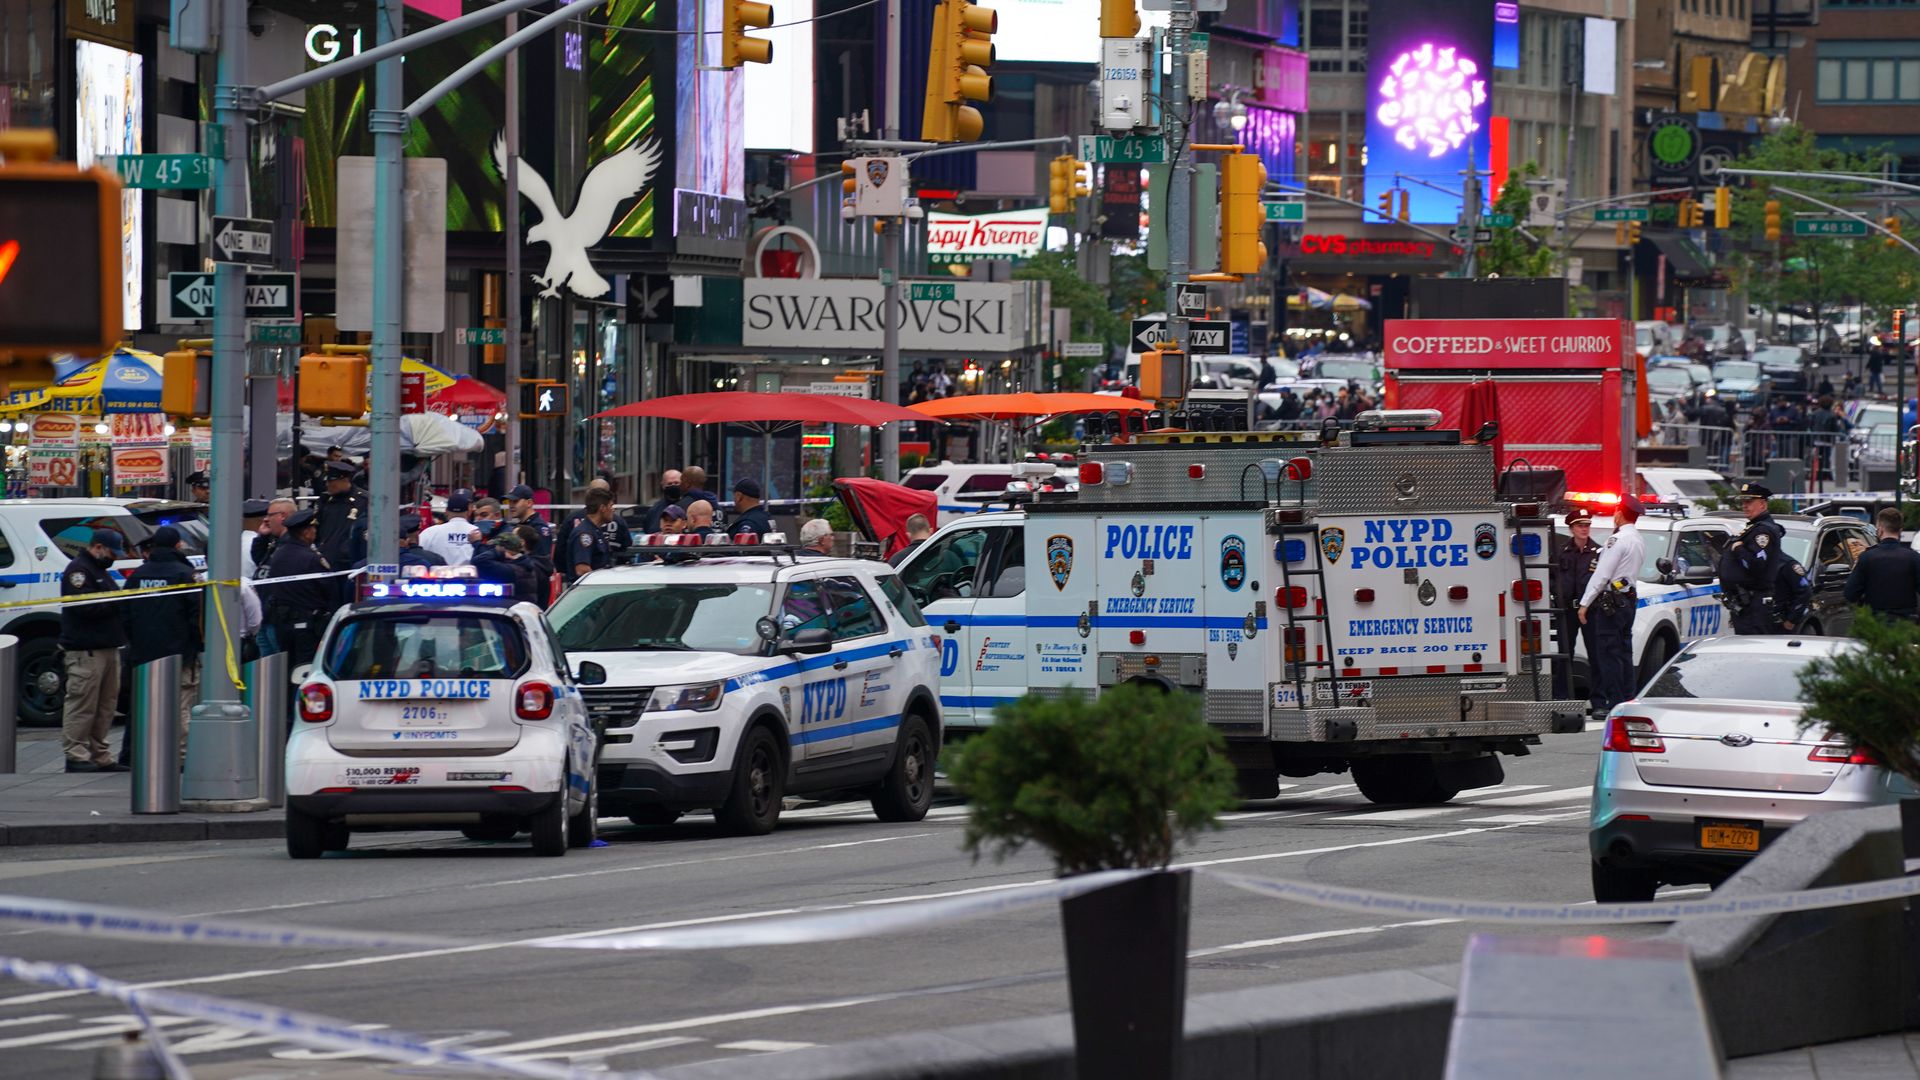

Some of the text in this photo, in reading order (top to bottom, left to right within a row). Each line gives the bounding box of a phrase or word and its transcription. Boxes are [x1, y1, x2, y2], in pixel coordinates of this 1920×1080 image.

[1105, 68, 1137, 80] 726159
[1100, 139, 1162, 159] W 45 St
[123, 158, 208, 184] W 45 St
[1273, 205, 1285, 217] St
[970, 219, 1041, 247] Kreme
[1808, 223, 1817, 232] W
[1841, 223, 1853, 232] St
[222, 231, 268, 251] ONE WAY
[1301, 234, 1347, 254] CVS
[1350, 238, 1436, 257] pharmacy
[189, 287, 213, 305] ON
[913, 286, 923, 298] W
[928, 286, 941, 298] 46
[749, 294, 1006, 335] SWAROVSKI
[468, 331, 477, 341] W
[481, 330, 493, 342] 46
[1147, 330, 1218, 345] ON WAY
[1392, 336, 1493, 354] COFFEED
[1504, 336, 1547, 353] SWEET
[1551, 335, 1612, 353] CHURROS
[1364, 518, 1452, 543] NYPD
[1105, 524, 1194, 560] POLICE
[1351, 544, 1469, 569] POLICE
[140, 579, 167, 589] NYPD
[401, 583, 466, 597] YOUR
[1106, 598, 1195, 614] EMERGENCY SERVICE
[1349, 617, 1472, 637] EMERGENCY SERVICE
[1688, 604, 1721, 637] NYPD
[1337, 643, 1488, 656] KEEP BACK 200 FEET
[359, 680, 490, 698] NYPD POLICE
[1277, 691, 1296, 702] 574
[800, 677, 847, 725] NYPD
[403, 707, 436, 719] 2706
[346, 767, 420, 776] $10,000 REWARD
